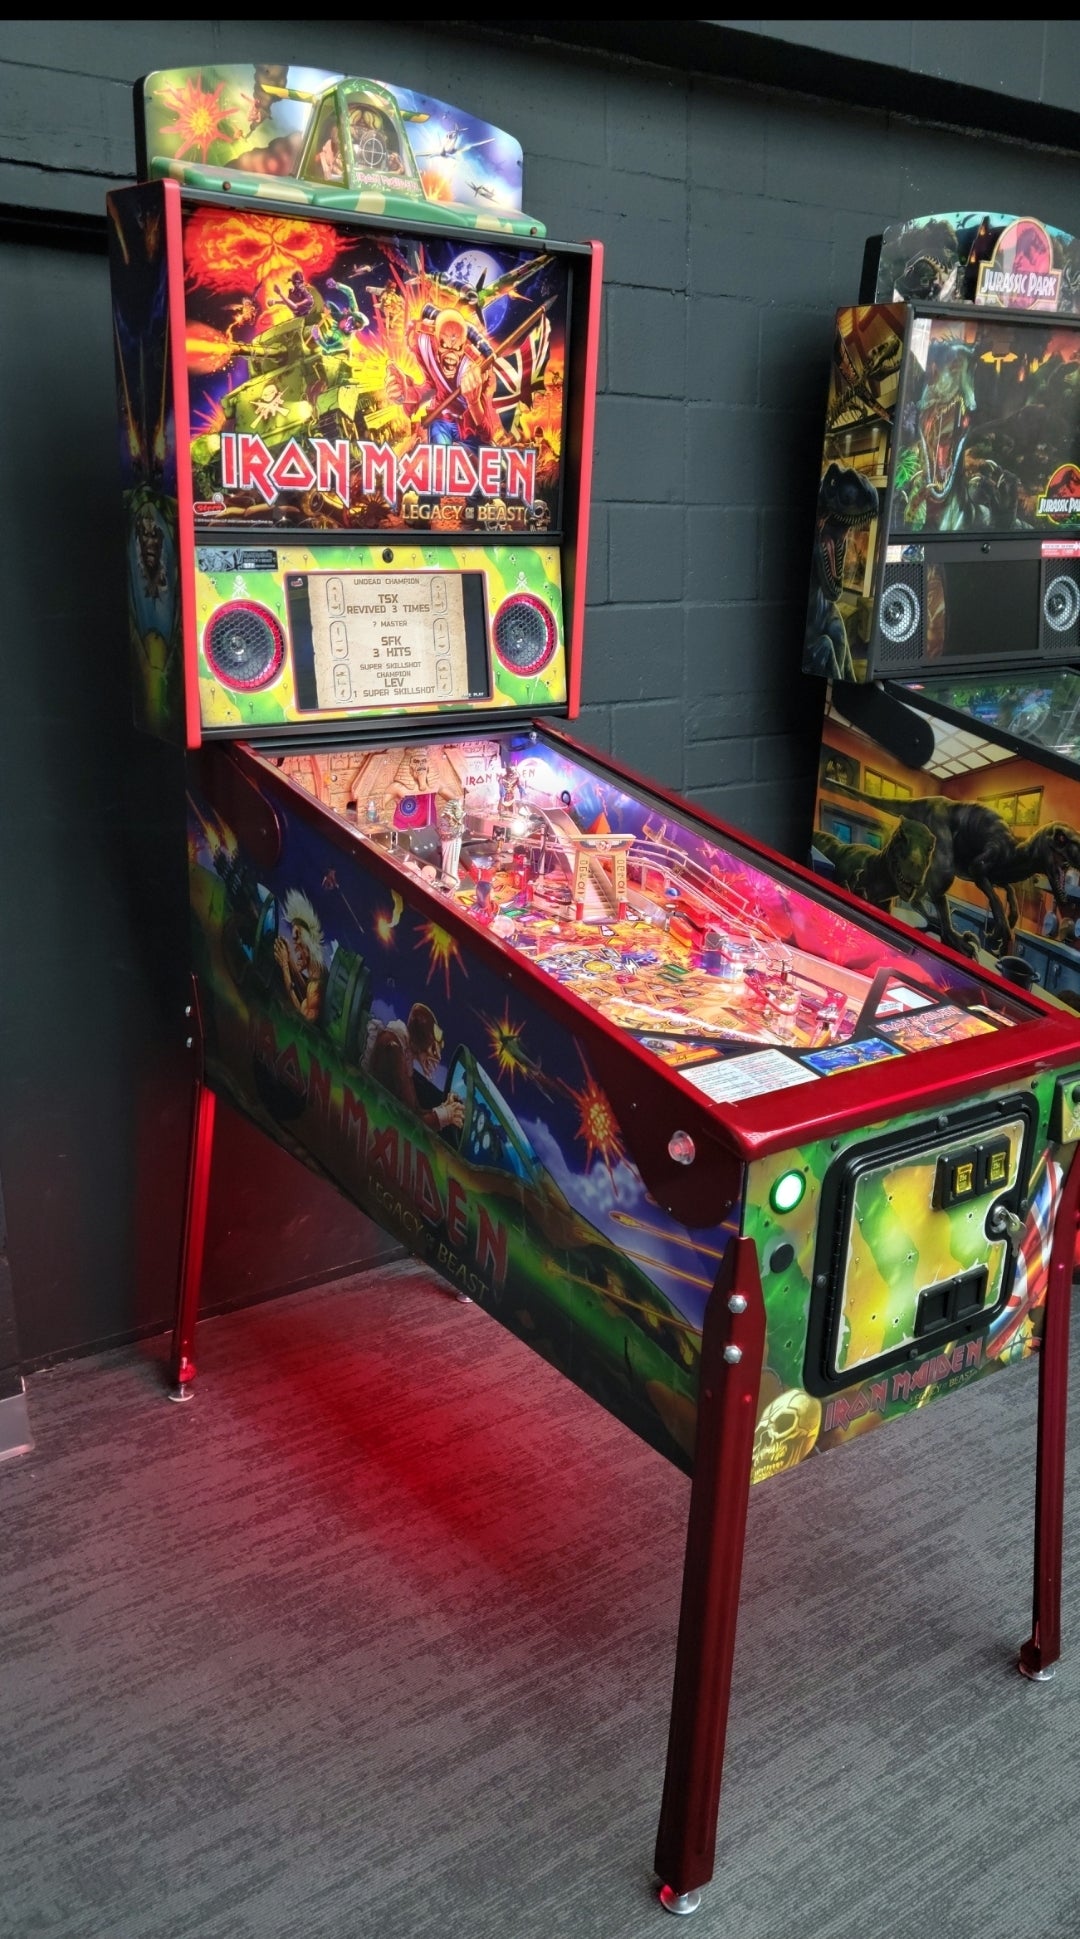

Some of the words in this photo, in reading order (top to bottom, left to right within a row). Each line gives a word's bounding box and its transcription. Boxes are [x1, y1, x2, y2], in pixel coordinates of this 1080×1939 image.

[981, 268, 1027, 293] JURASSIC
[1027, 272, 1057, 296] PARK
[221, 432, 350, 510] IRON
[356, 440, 537, 516] MAIDEN
[1039, 498, 1069, 513] JURASSIC
[402, 504, 463, 520] LEGACY
[477, 505, 525, 521] BEAST
[378, 594, 398, 603] TSX
[346, 605, 386, 614] REVIVED
[392, 605, 398, 613] 3
[403, 604, 430, 613] TIMES
[381, 635, 402, 646] SFK
[373, 648, 379, 658] 3
[386, 647, 411, 657] HITS
[386, 661, 421, 669] SKILLSHOT
[384, 678, 404, 687] LEV
[363, 688, 390, 697] SUPER
[394, 686, 435, 696] SKILLSHOT
[465, 773, 493, 786] IRON
[340, 1081, 510, 1301] MAIDEN
[437, 1242, 489, 1300] BEAST
[824, 1378, 889, 1433] IRON
[892, 1336, 984, 1402] MAIDEN
